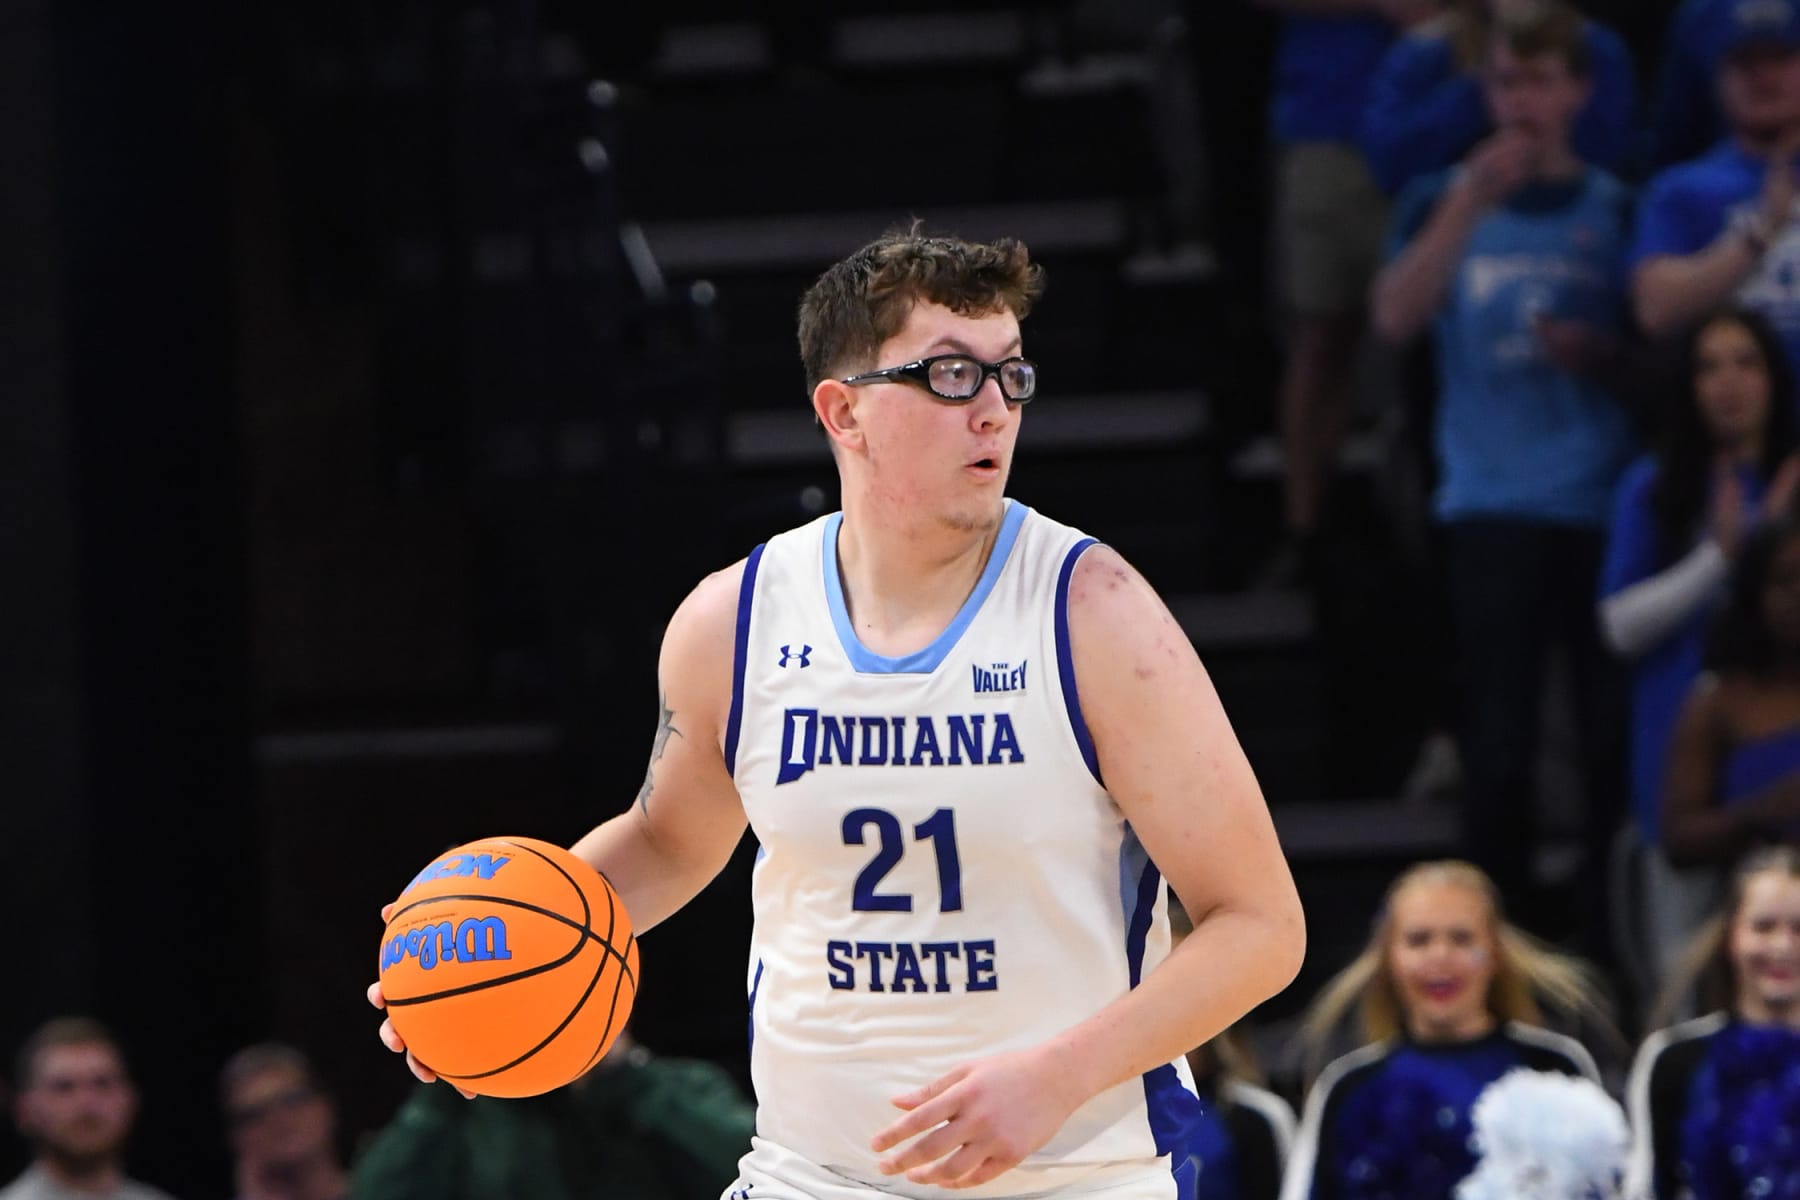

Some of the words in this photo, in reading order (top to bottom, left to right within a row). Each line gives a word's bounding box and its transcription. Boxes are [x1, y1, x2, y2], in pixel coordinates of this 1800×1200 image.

[972, 659, 1027, 693] VALLEY
[776, 708, 1025, 784] INDIANA
[840, 807, 964, 913] 21
[381, 915, 512, 973] Wilson
[826, 939, 998, 993] STATE
